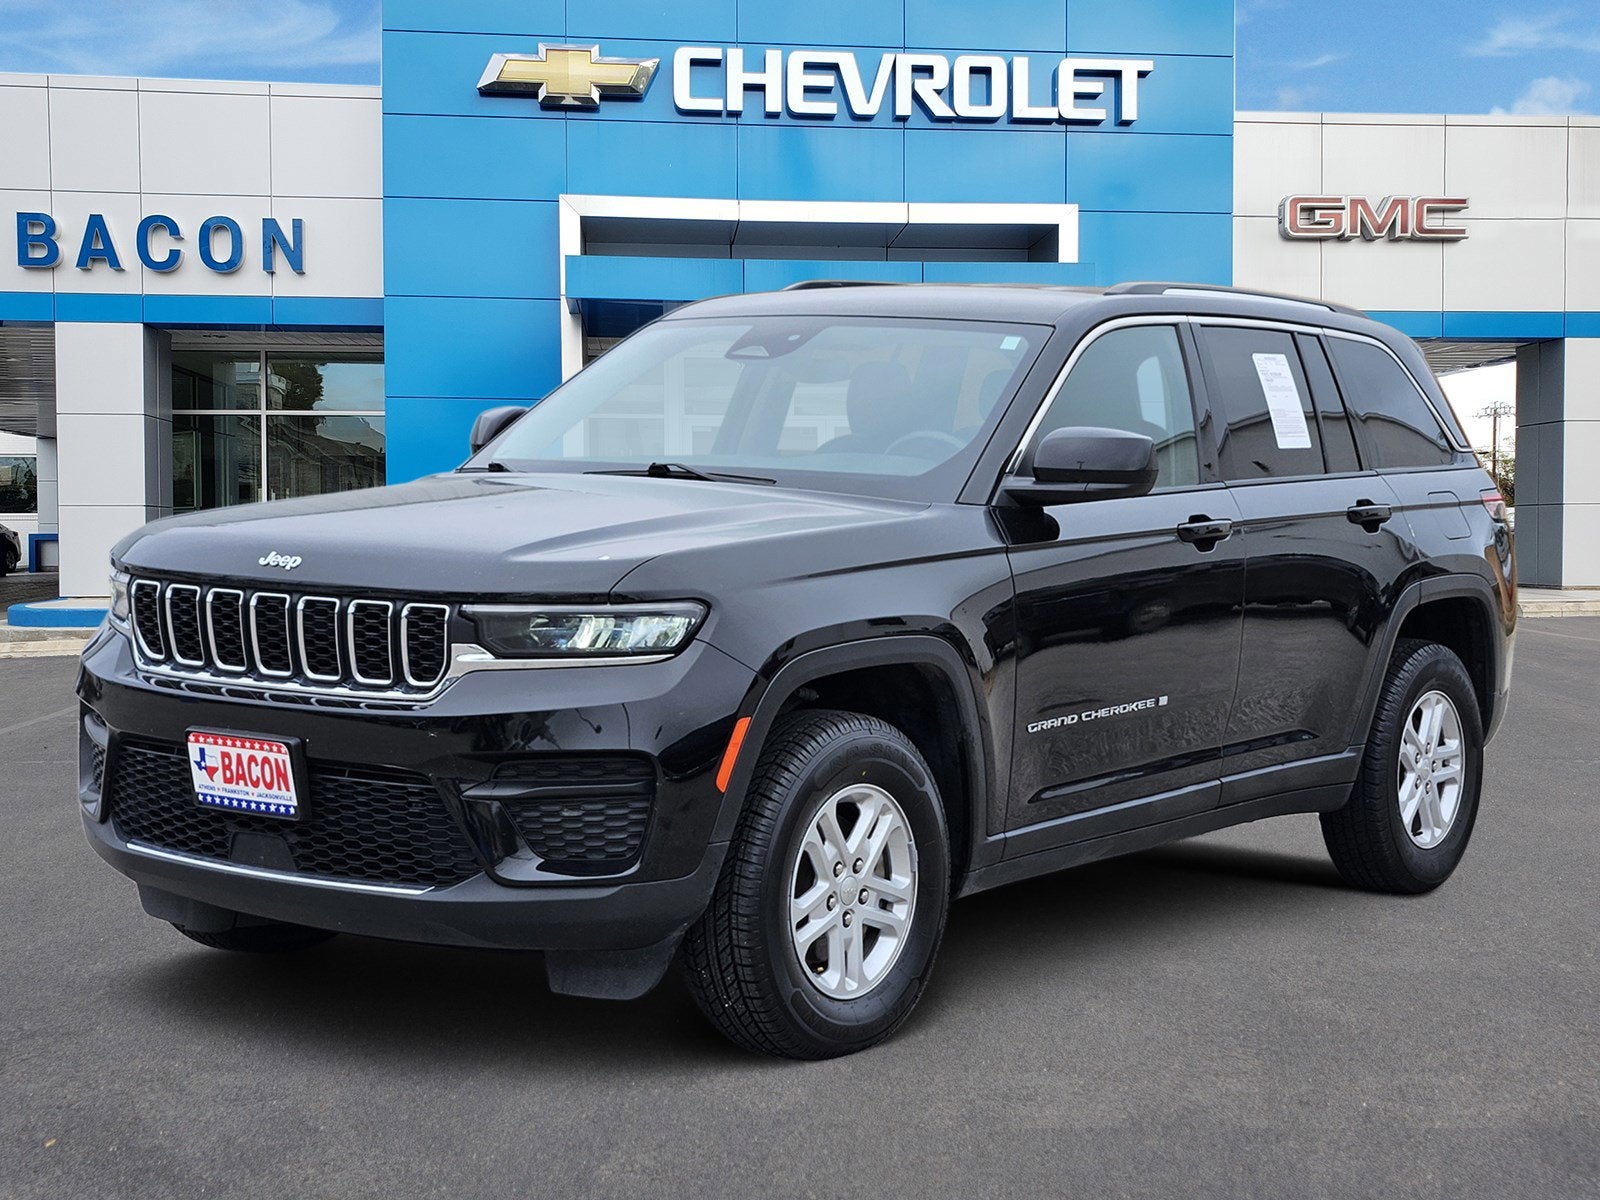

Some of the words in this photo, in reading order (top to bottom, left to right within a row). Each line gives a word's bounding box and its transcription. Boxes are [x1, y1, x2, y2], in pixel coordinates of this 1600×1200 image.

[673, 46, 1154, 126] CHEVROLET
[1279, 194, 1469, 241] GMC
[16, 211, 306, 275] BACON
[258, 550, 303, 571] Jeep
[1027, 714, 1078, 733] GRAND
[1081, 698, 1156, 722] CHEROKEE
[220, 750, 291, 792] BACON
[198, 783, 216, 792] ATHENS
[256, 792, 293, 802] JACKSONVILLE
